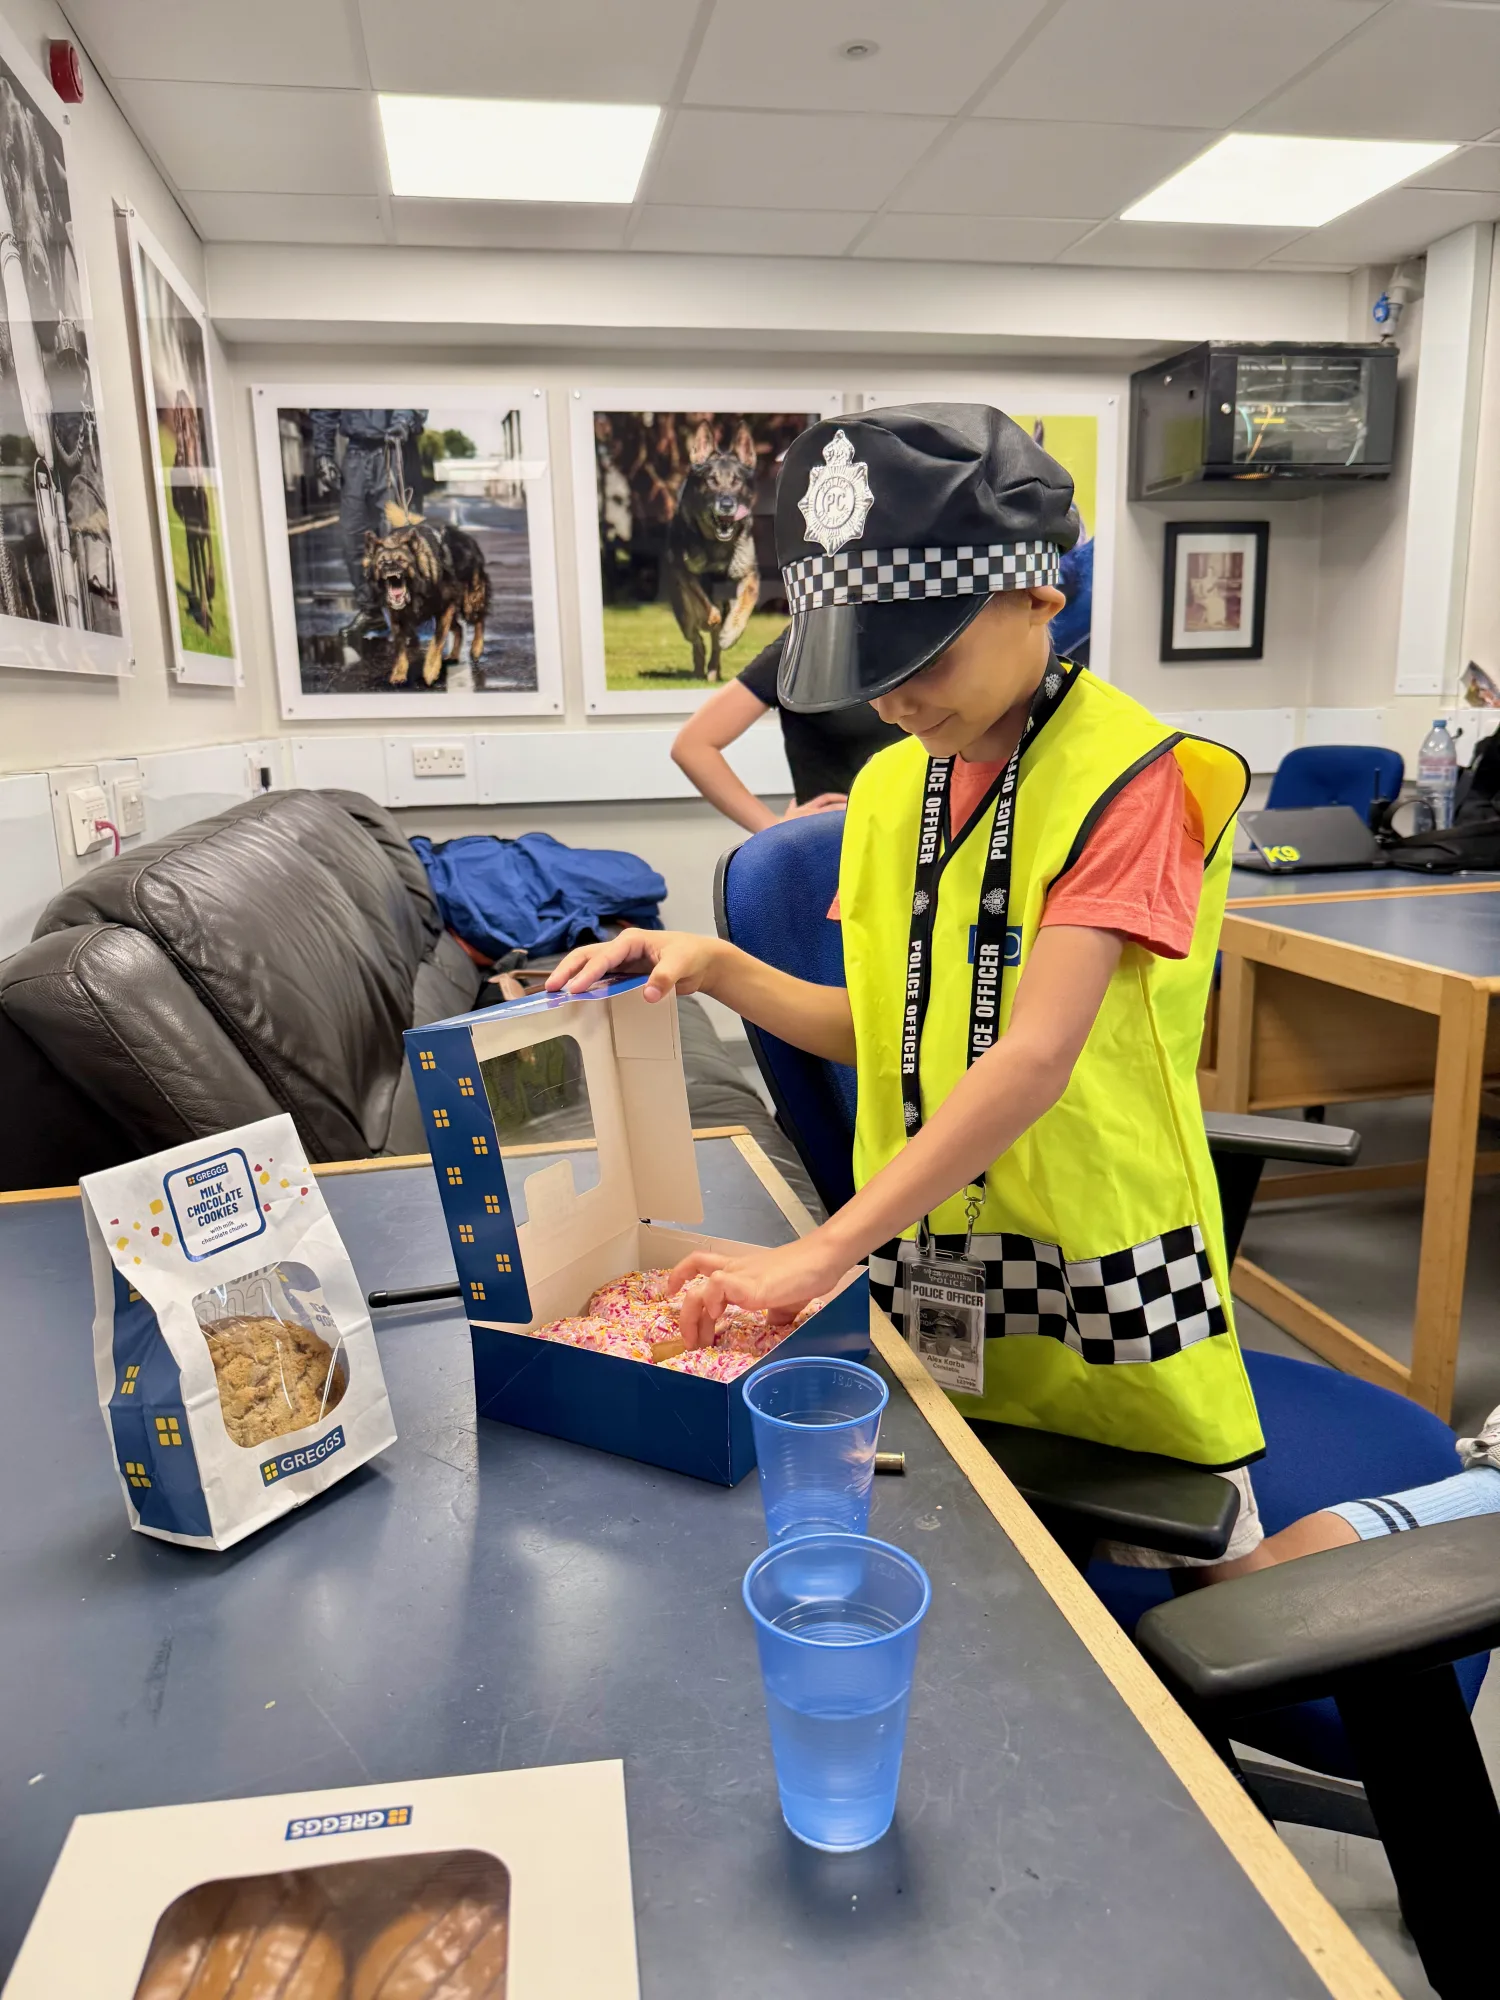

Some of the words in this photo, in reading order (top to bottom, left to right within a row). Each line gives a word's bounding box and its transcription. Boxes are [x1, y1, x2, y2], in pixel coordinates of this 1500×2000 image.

[827, 493, 846, 512] PC
[927, 758, 950, 793] LICE
[919, 797, 942, 865] OFFICER
[990, 797, 1012, 860] POLICE
[1263, 846, 1300, 863] K9
[907, 940, 922, 1000] POLICE
[975, 943, 1000, 1018] OFFICER
[903, 1004, 918, 1074] OFFICER
[195, 1164, 227, 1182] GREGGS
[187, 1188, 243, 1218] CHOCOLATE
[200, 1182, 224, 1200] MILK
[197, 1203, 239, 1227] COOKIES
[201, 1231, 228, 1245] chocolate
[229, 1222, 248, 1234] chunks
[210, 1224, 223, 1234] with
[223, 1221, 235, 1229] milk
[930, 1276, 966, 1288] POLICE
[913, 1285, 944, 1300] POLICE
[946, 1290, 983, 1307] OFFICER
[927, 1354, 942, 1364] Alex
[281, 1432, 341, 1472] GREGGS
[290, 1811, 385, 1838] GREGGS
